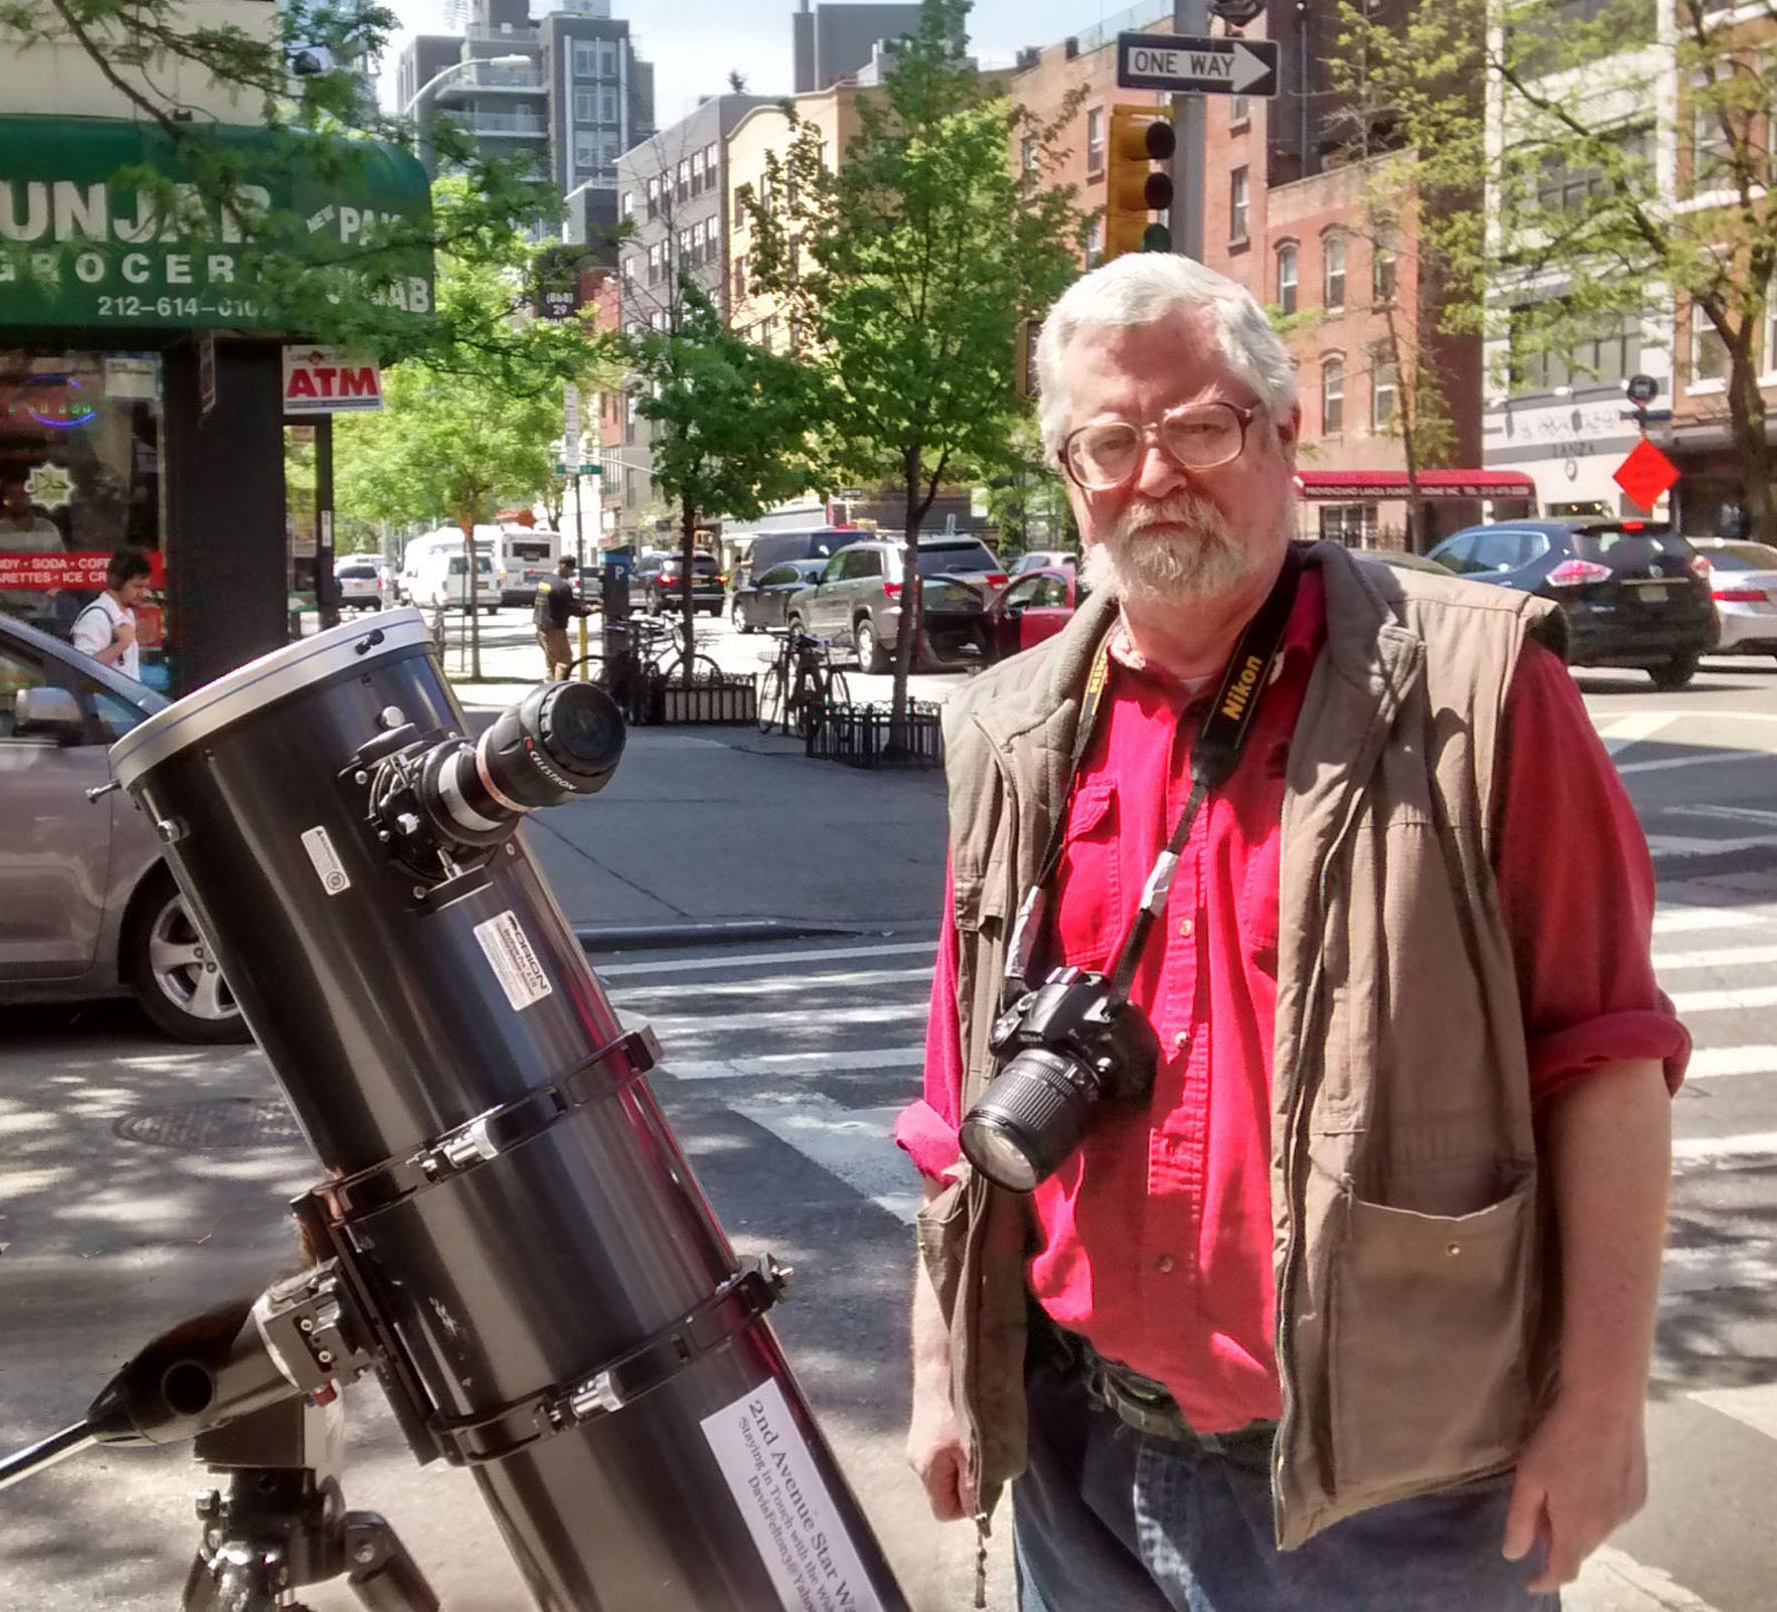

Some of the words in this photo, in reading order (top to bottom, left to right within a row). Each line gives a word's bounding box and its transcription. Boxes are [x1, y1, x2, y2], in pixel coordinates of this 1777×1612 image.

[1134, 50, 1177, 74] ONE
[1190, 54, 1235, 77] WAY
[306, 204, 335, 234] NEW
[287, 367, 379, 398] ATM
[31, 558, 68, 569] SODA
[63, 572, 84, 583] ICE
[614, 565, 625, 580] P
[1222, 655, 1263, 720] Nikon
[529, 750, 578, 791] CELESTRON
[515, 931, 548, 990] ORION
[738, 1416, 766, 1472] Staying
[762, 1469, 774, 1487] in
[769, 1485, 795, 1530] Touch
[791, 1528, 809, 1560] with
[804, 1561, 820, 1585] the
[749, 1400, 780, 1446] 2nd
[771, 1450, 816, 1532] Avenue
[810, 1532, 838, 1579] Star
